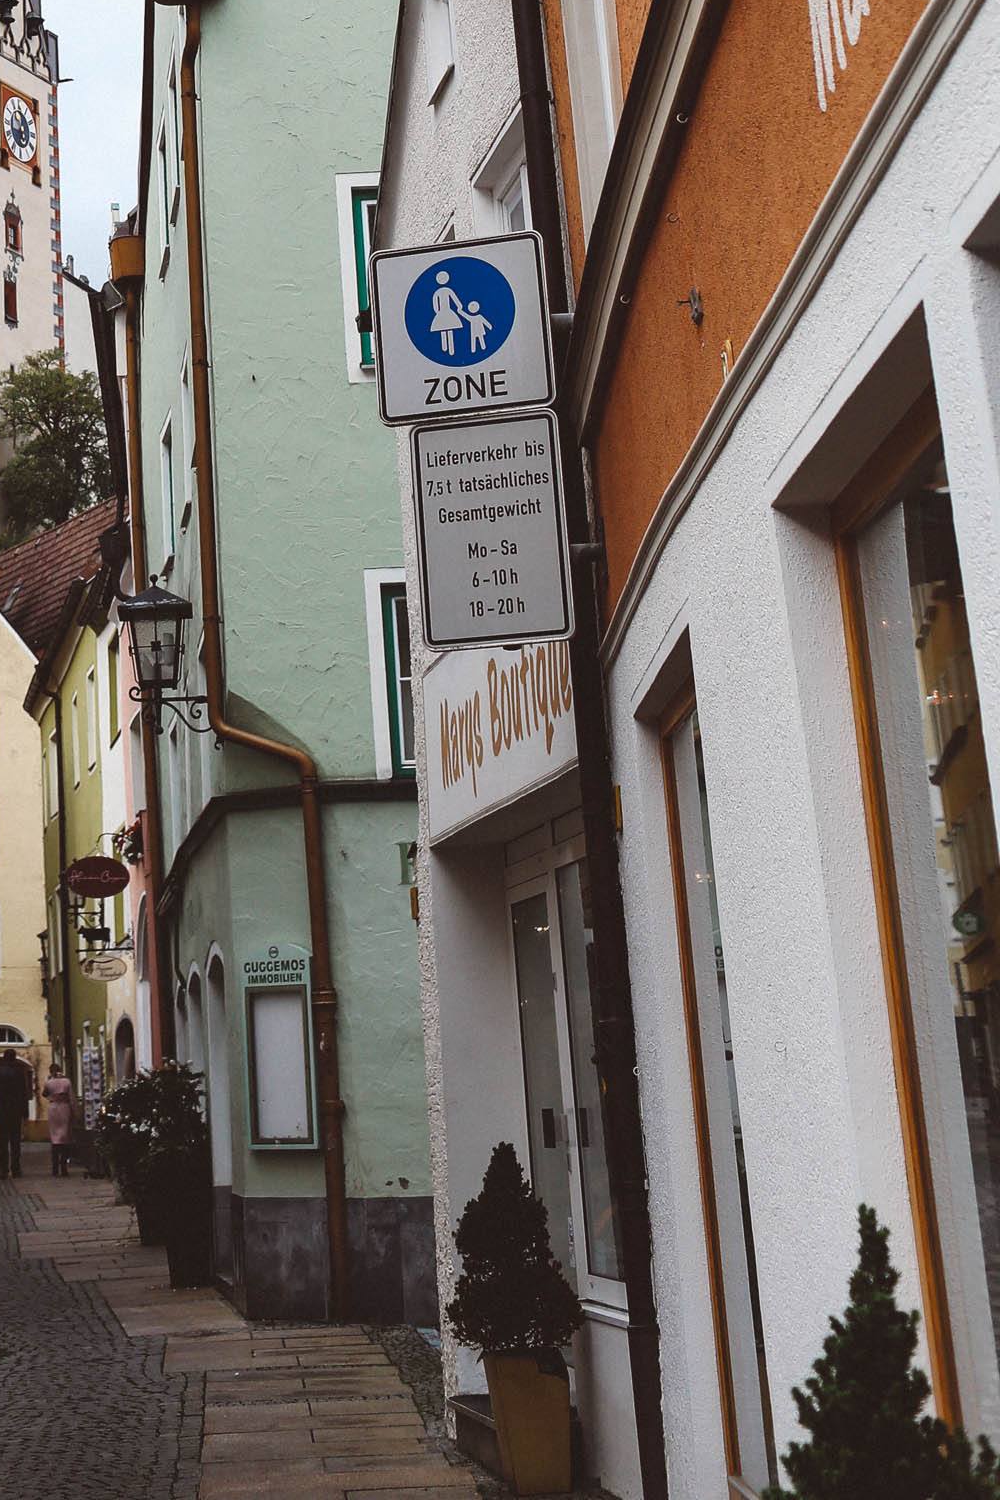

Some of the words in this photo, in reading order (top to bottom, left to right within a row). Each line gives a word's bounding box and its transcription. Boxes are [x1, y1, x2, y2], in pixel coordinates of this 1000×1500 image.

[424, 370, 508, 405] ZONE
[426, 443, 518, 469] Lieferverkehr
[524, 440, 545, 457] bis
[459, 470, 549, 494] tatsächliches
[438, 498, 542, 523] Gesamtgewicht
[440, 690, 483, 798] Marys
[487, 641, 572, 756] Boutique
[244, 959, 305, 973] GUGGEMOS
[248, 973, 302, 984] IMMOBILIEN
